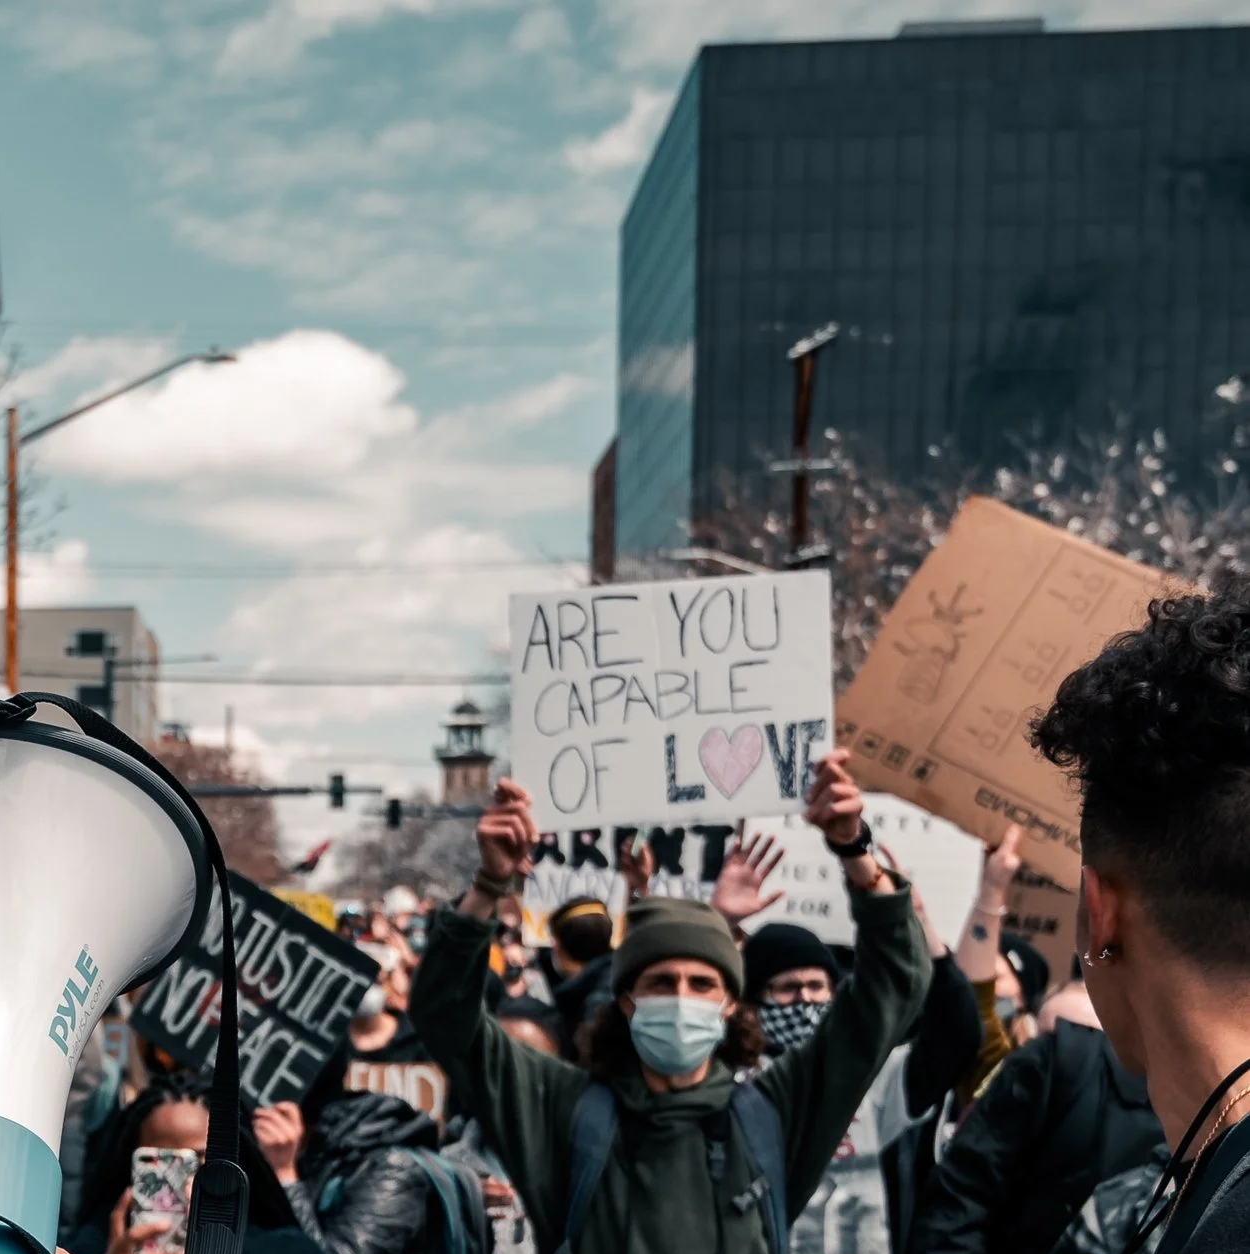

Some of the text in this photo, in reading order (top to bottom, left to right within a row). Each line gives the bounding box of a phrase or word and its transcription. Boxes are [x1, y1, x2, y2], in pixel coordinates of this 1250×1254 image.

[521, 585, 781, 675] ARE YOU
[533, 659, 774, 738] CAPABLE
[548, 737, 631, 815] OF
[141, 956, 216, 1034] NO
[236, 909, 372, 1043] JUSTICE
